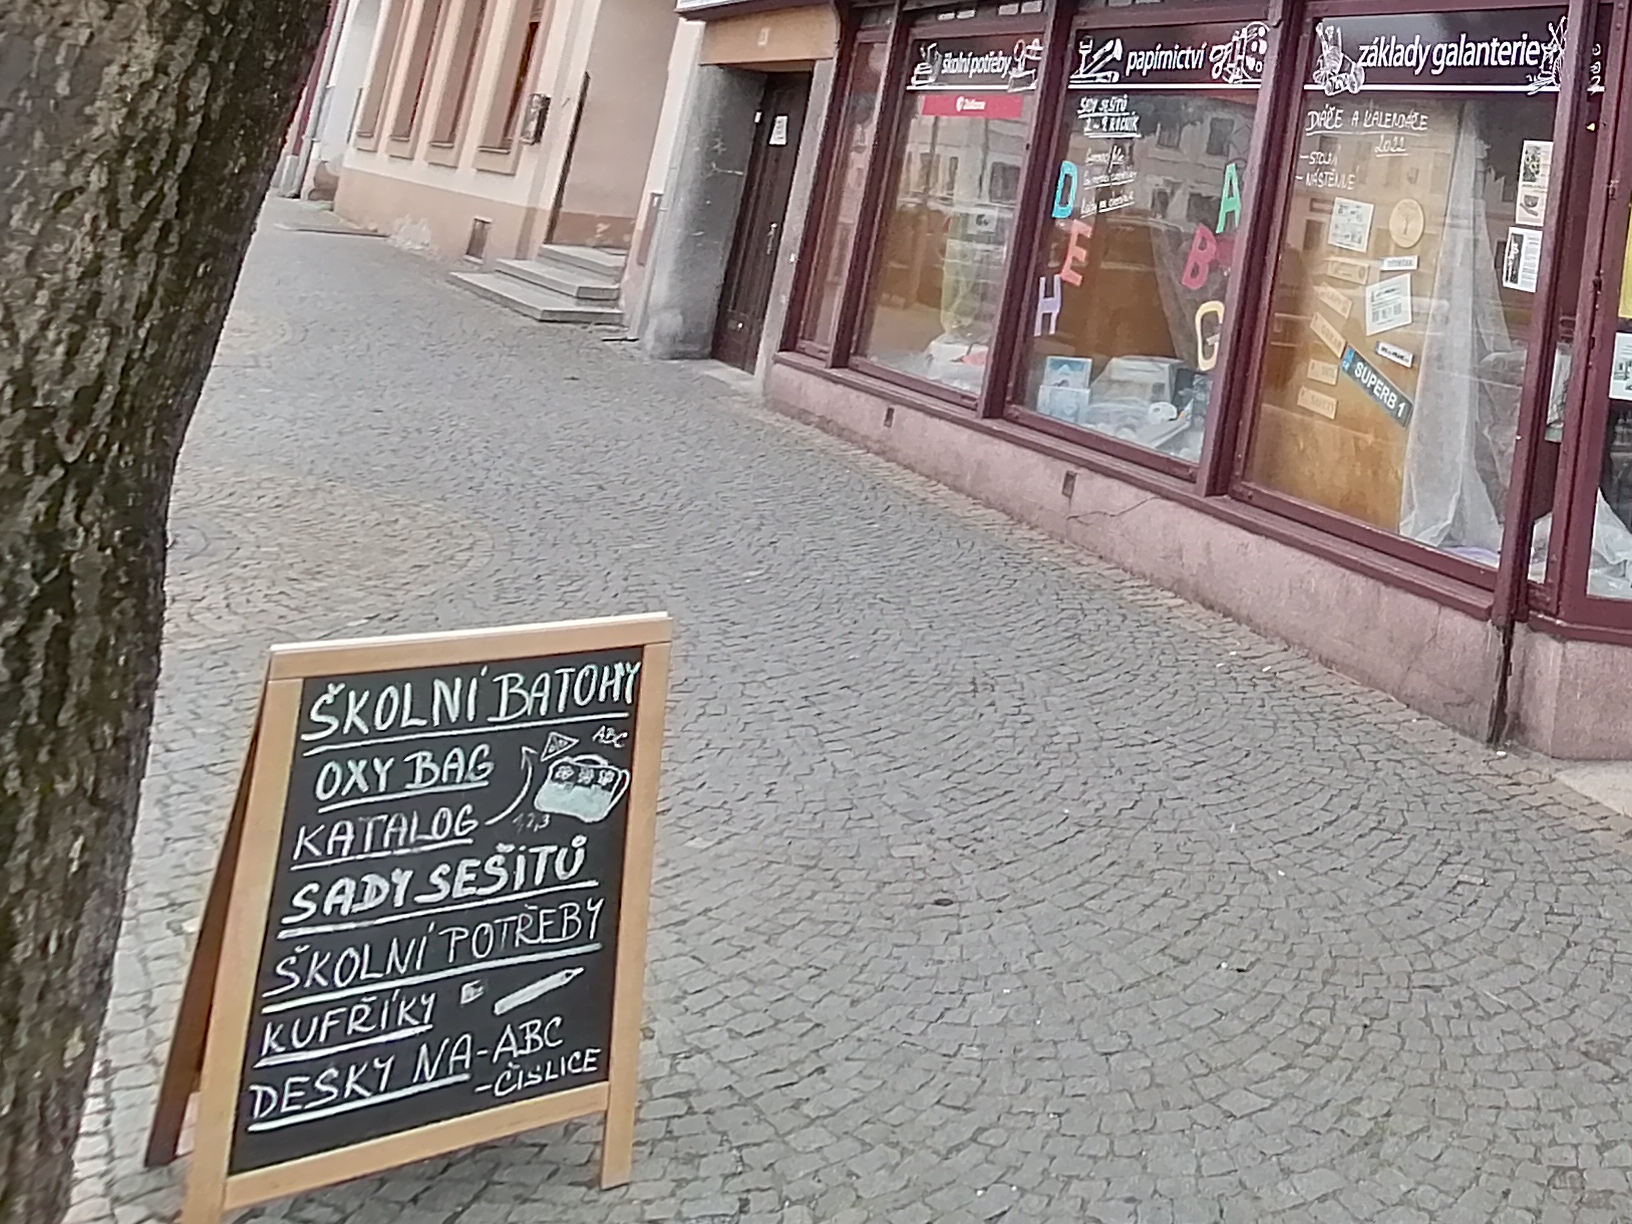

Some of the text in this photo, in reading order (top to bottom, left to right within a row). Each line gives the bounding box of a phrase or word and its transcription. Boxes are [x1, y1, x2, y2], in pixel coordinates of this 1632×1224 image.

[941, 50, 1012, 79] školní potřeby
[1125, 42, 1208, 77] papírnictví
[1358, 33, 1541, 76] základy galanterie
[1351, 110, 1359, 127] A
[1052, 160, 1078, 218] D
[1216, 163, 1242, 233] A
[1182, 225, 1218, 289] B
[1354, 361, 1398, 410] SUPERB
[1397, 402, 1406, 418] 1
[301, 661, 642, 741] ŠKOLNÍ BATOHY
[316, 744, 496, 801] OXY BAG
[293, 803, 479, 860] KATALOG
[282, 869, 413, 924] SADY
[262, 898, 606, 997] ŠKOLNÍ POTŘEBY
[260, 990, 437, 1055] KUFŘÍKY
[249, 1053, 394, 1118] DESKY
